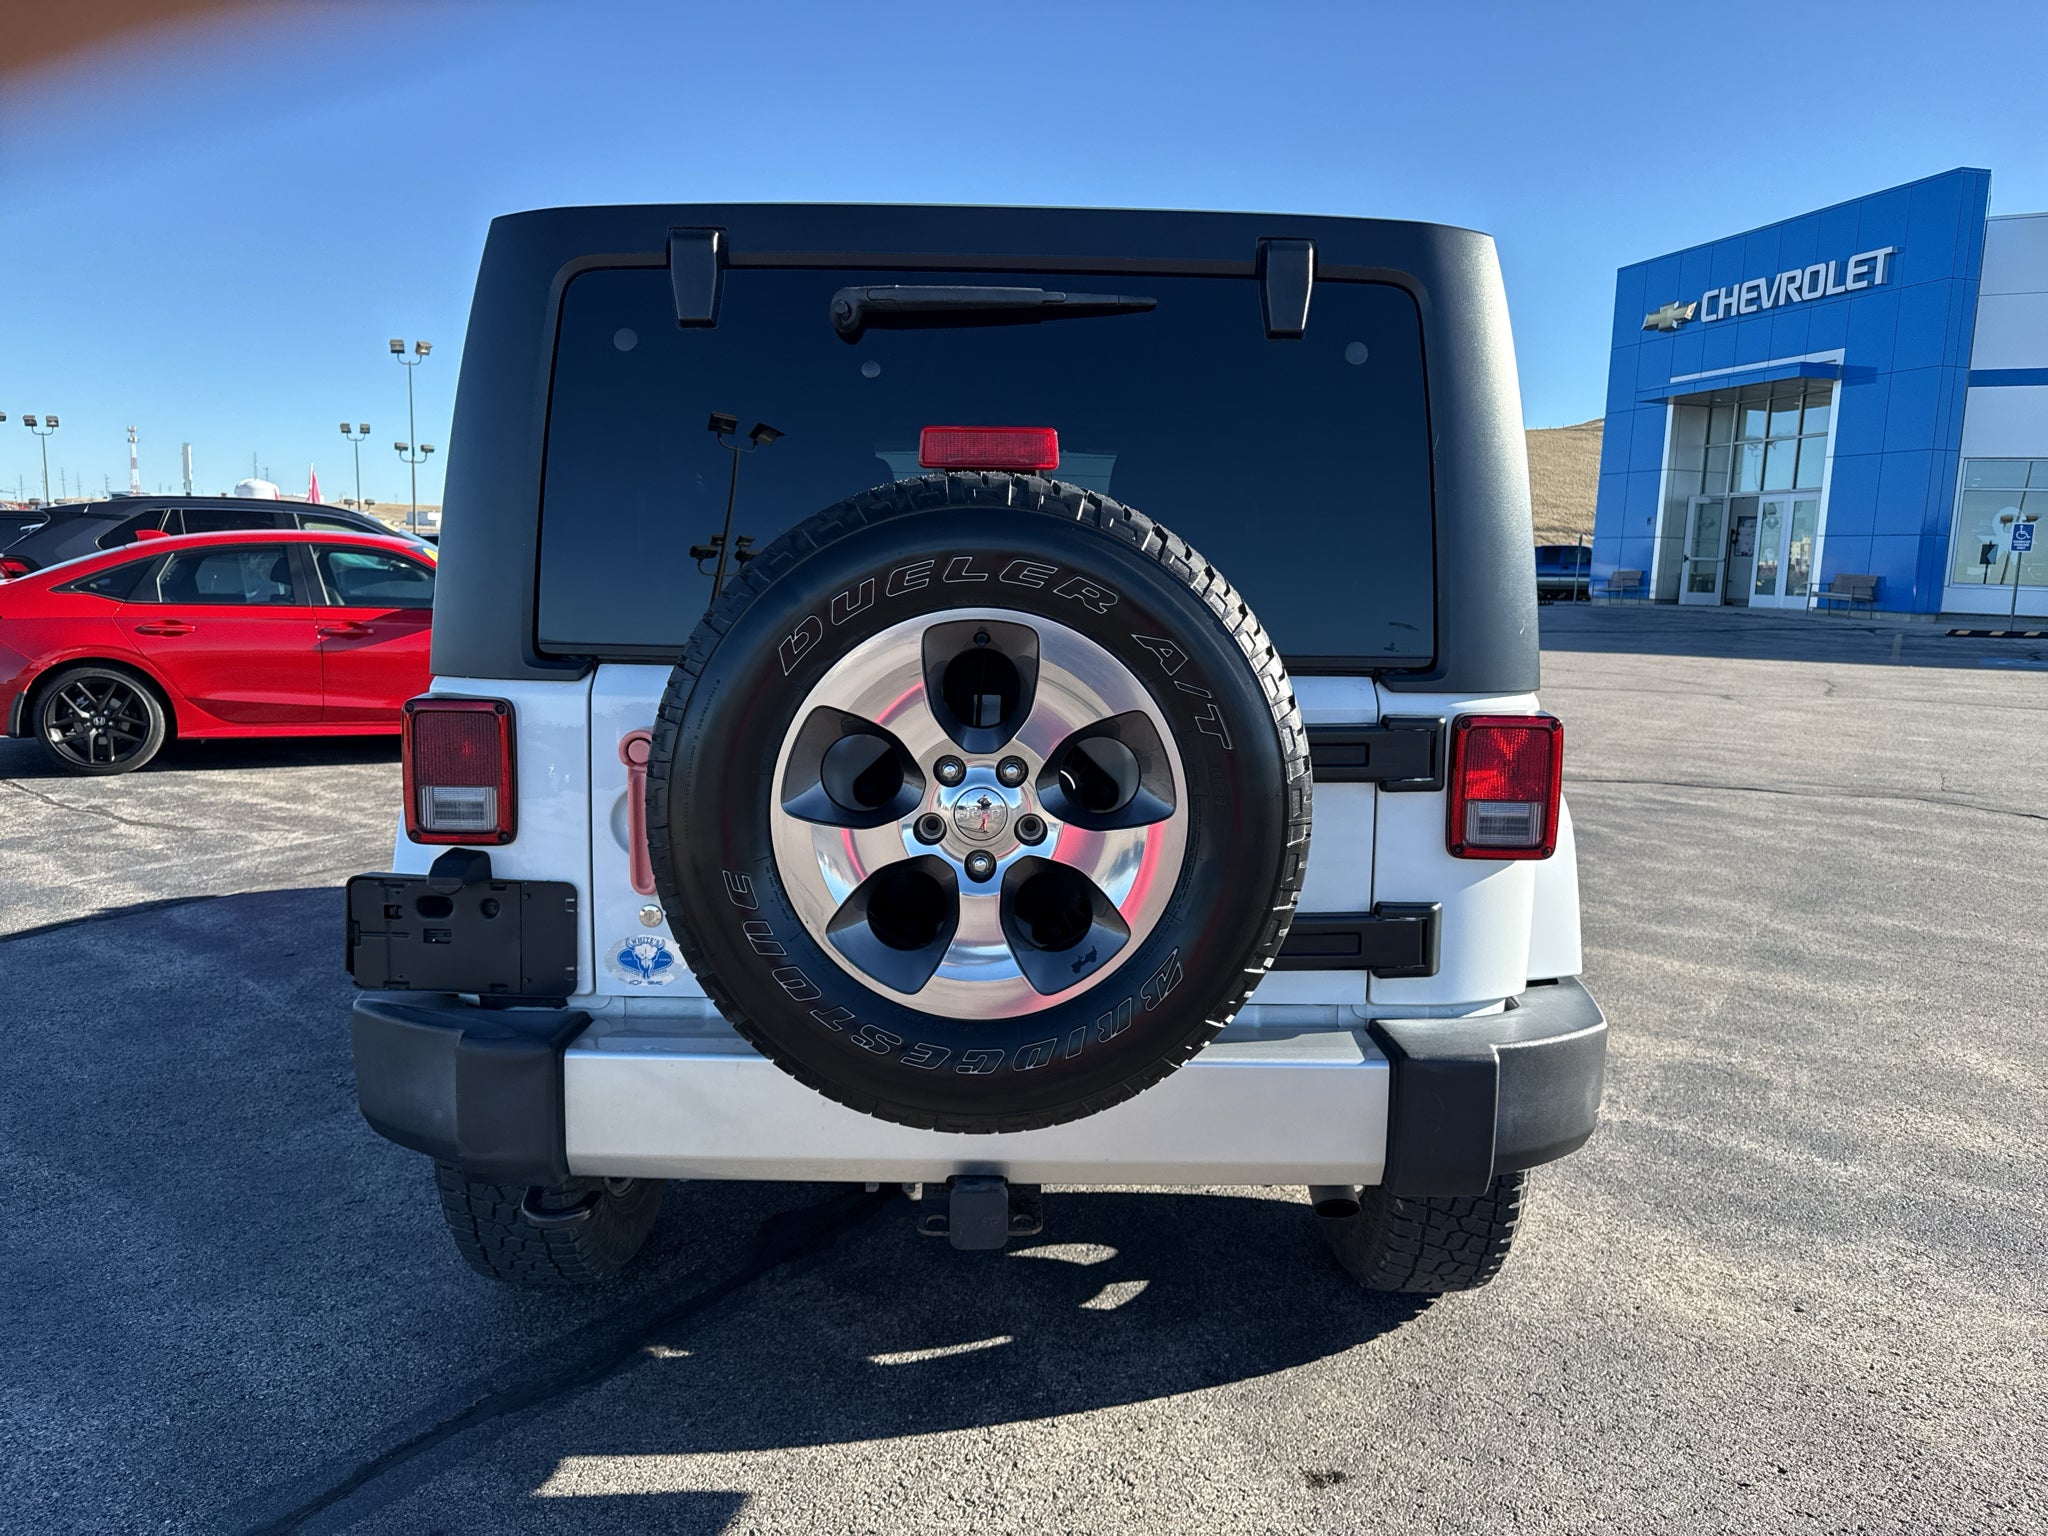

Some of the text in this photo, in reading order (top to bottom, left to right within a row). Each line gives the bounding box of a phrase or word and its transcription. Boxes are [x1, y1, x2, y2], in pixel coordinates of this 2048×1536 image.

[1701, 246, 1894, 322] CHEVROLET
[777, 556, 1233, 750] DUELER A/T
[722, 868, 1184, 1076] BRIDGESTONE
